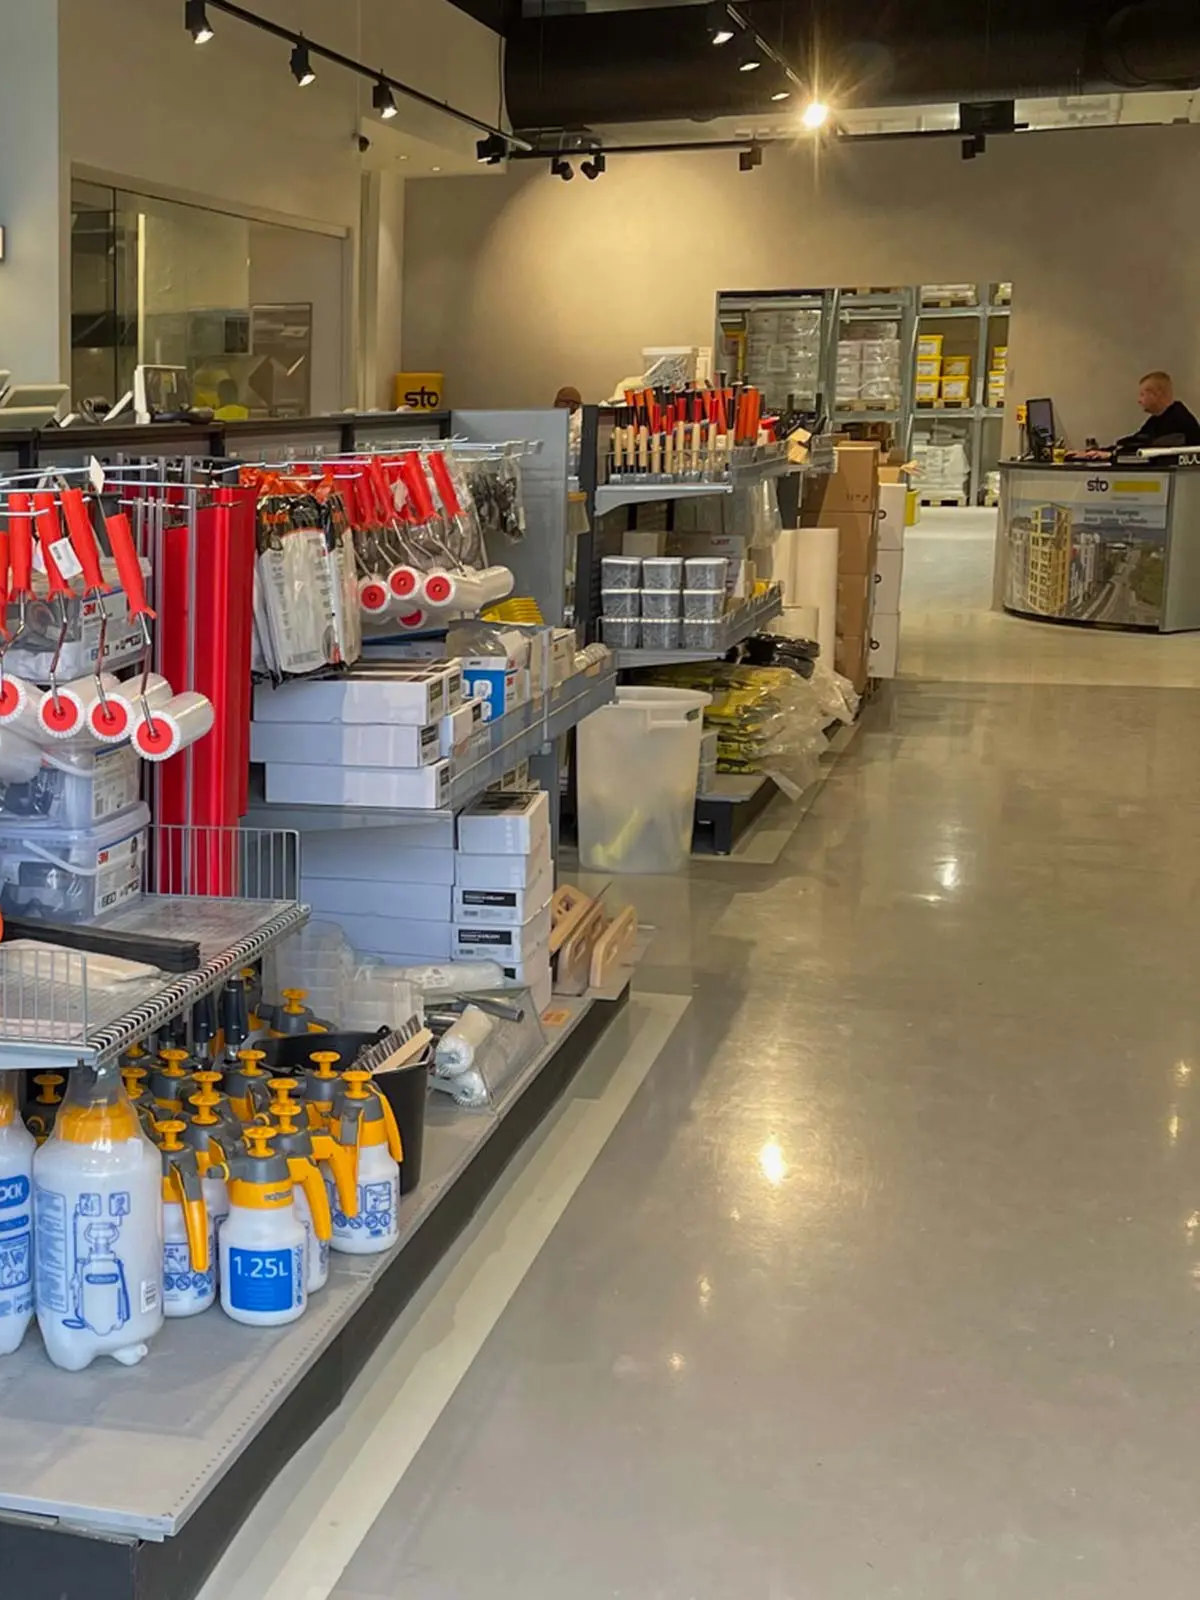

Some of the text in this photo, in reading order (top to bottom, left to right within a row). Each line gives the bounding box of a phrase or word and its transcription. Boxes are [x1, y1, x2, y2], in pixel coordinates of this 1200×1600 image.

[404, 385, 439, 408] sto
[1086, 476, 1109, 492] sto
[233, 1255, 289, 1279] 1.25L
